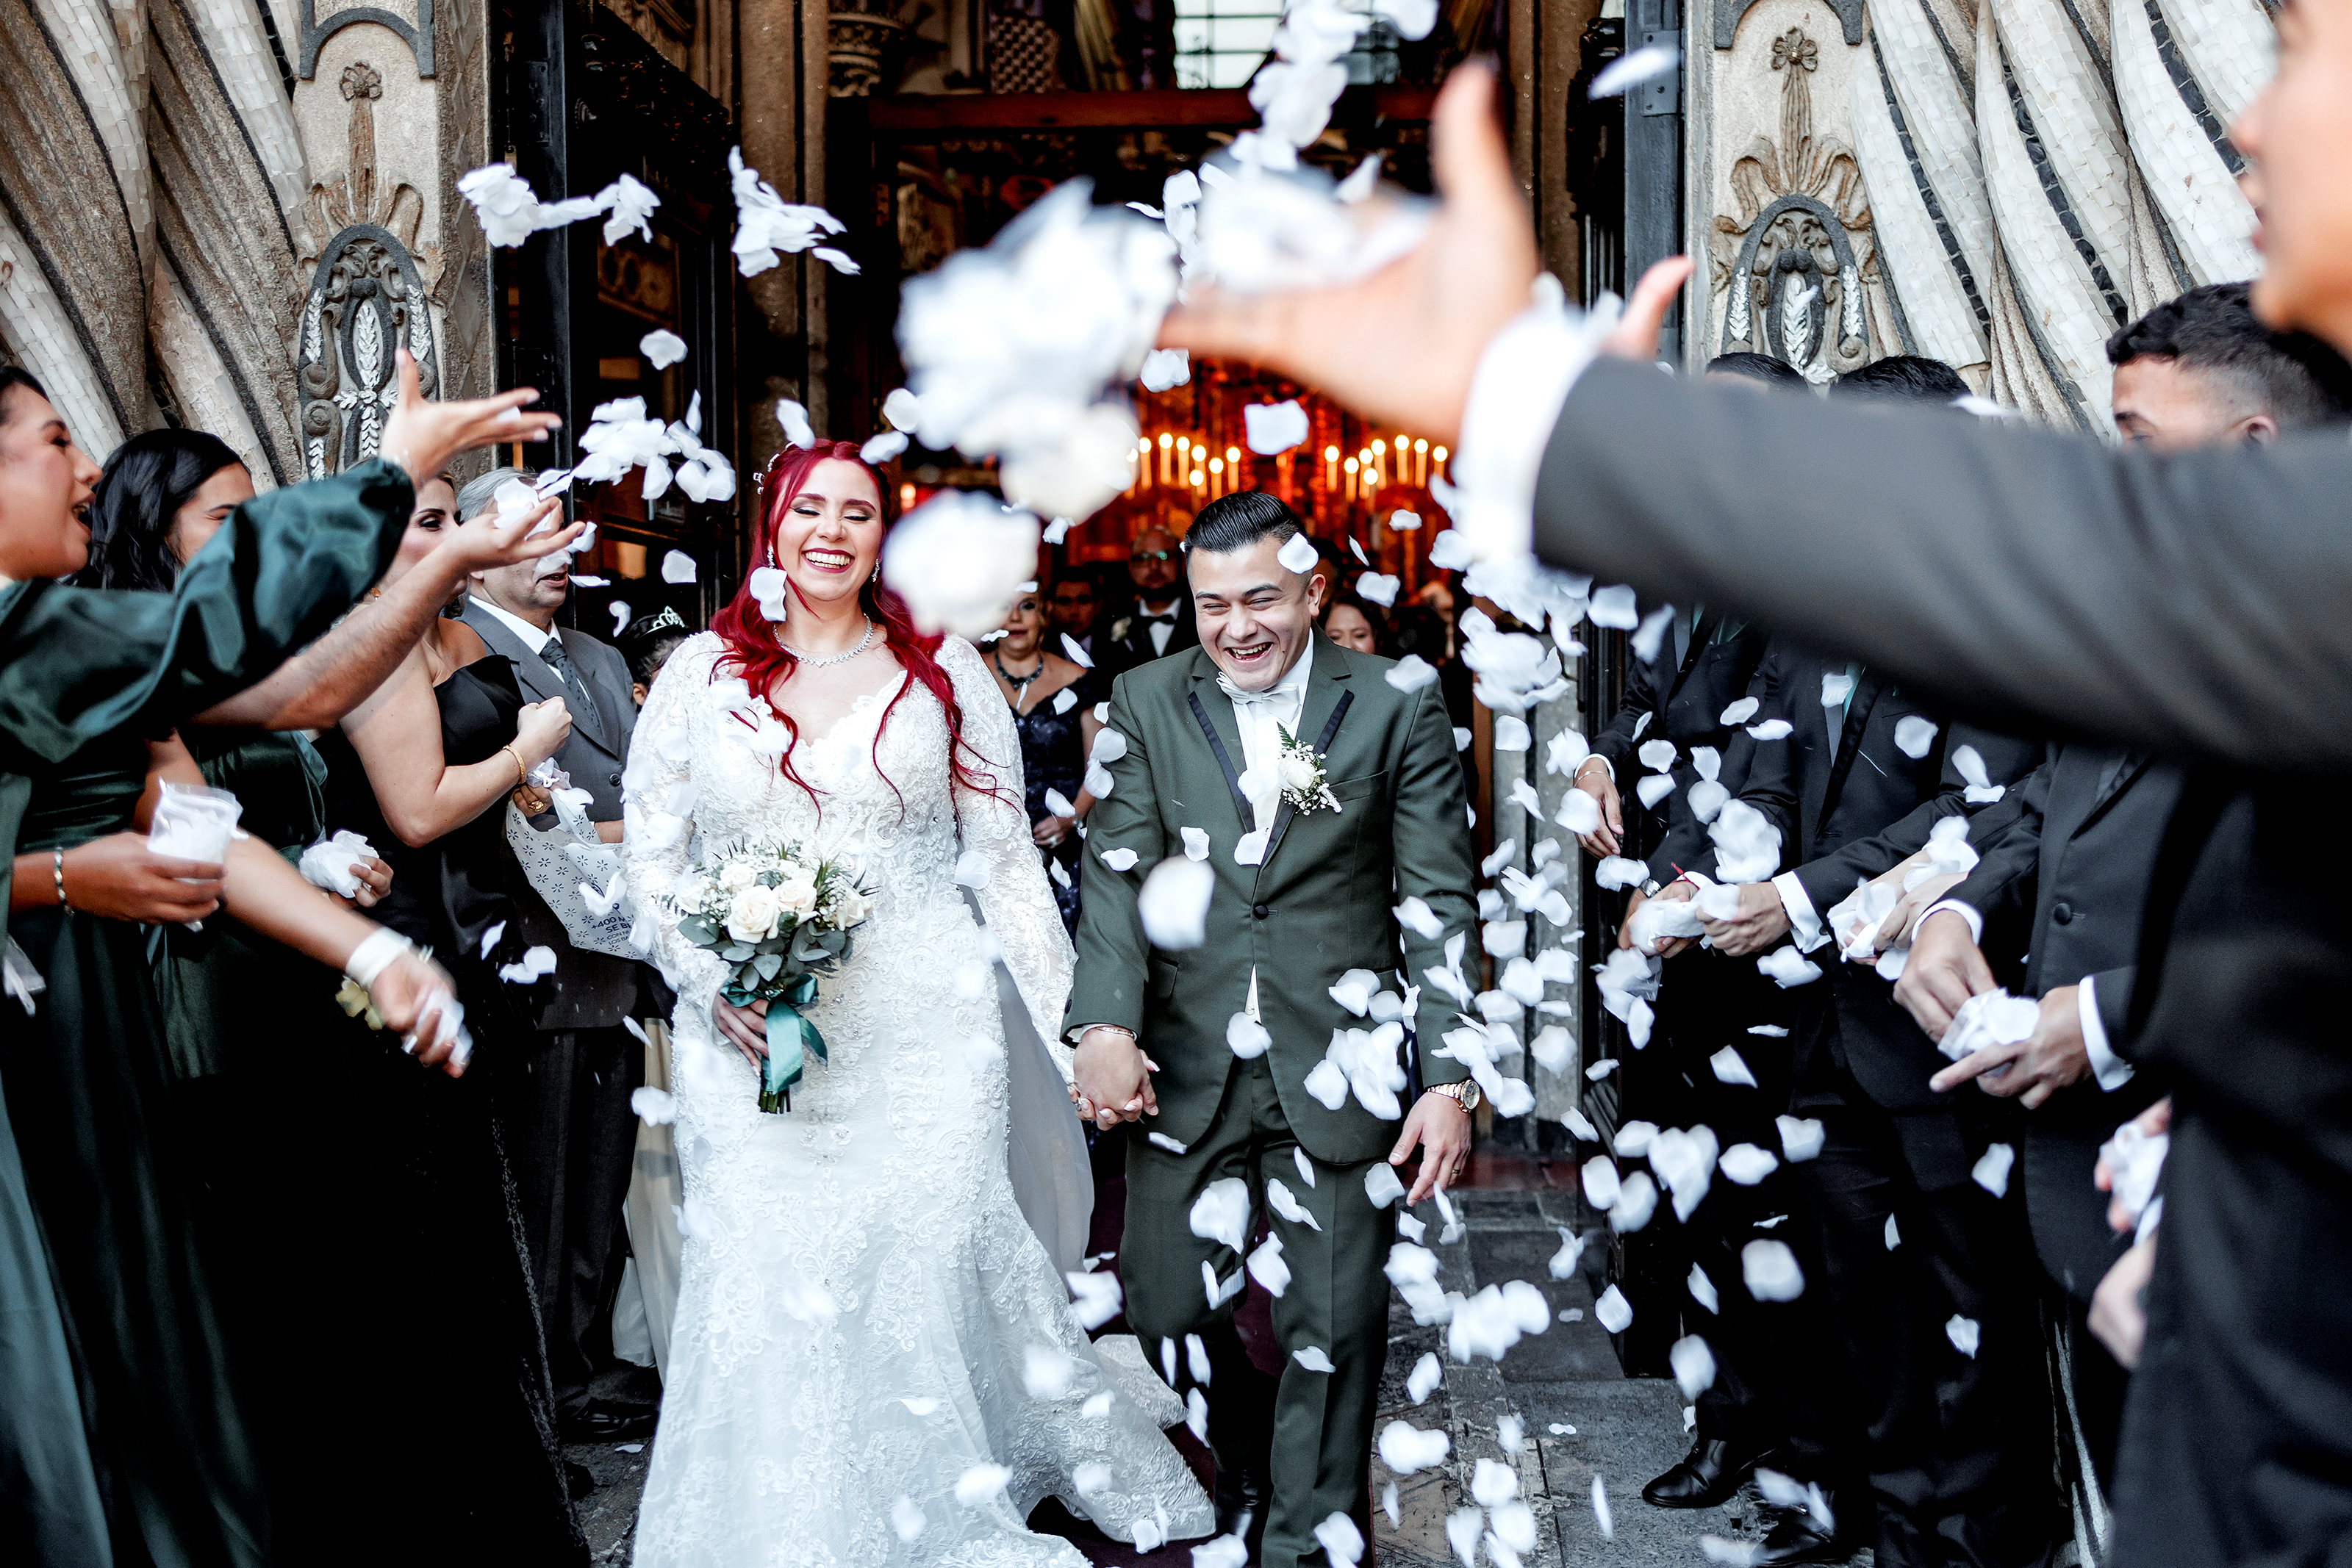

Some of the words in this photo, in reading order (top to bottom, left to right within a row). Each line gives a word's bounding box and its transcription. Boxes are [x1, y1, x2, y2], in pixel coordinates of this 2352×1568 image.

[592, 916, 617, 929] +400
[606, 924, 620, 933] SE
[606, 932, 622, 940] CON
